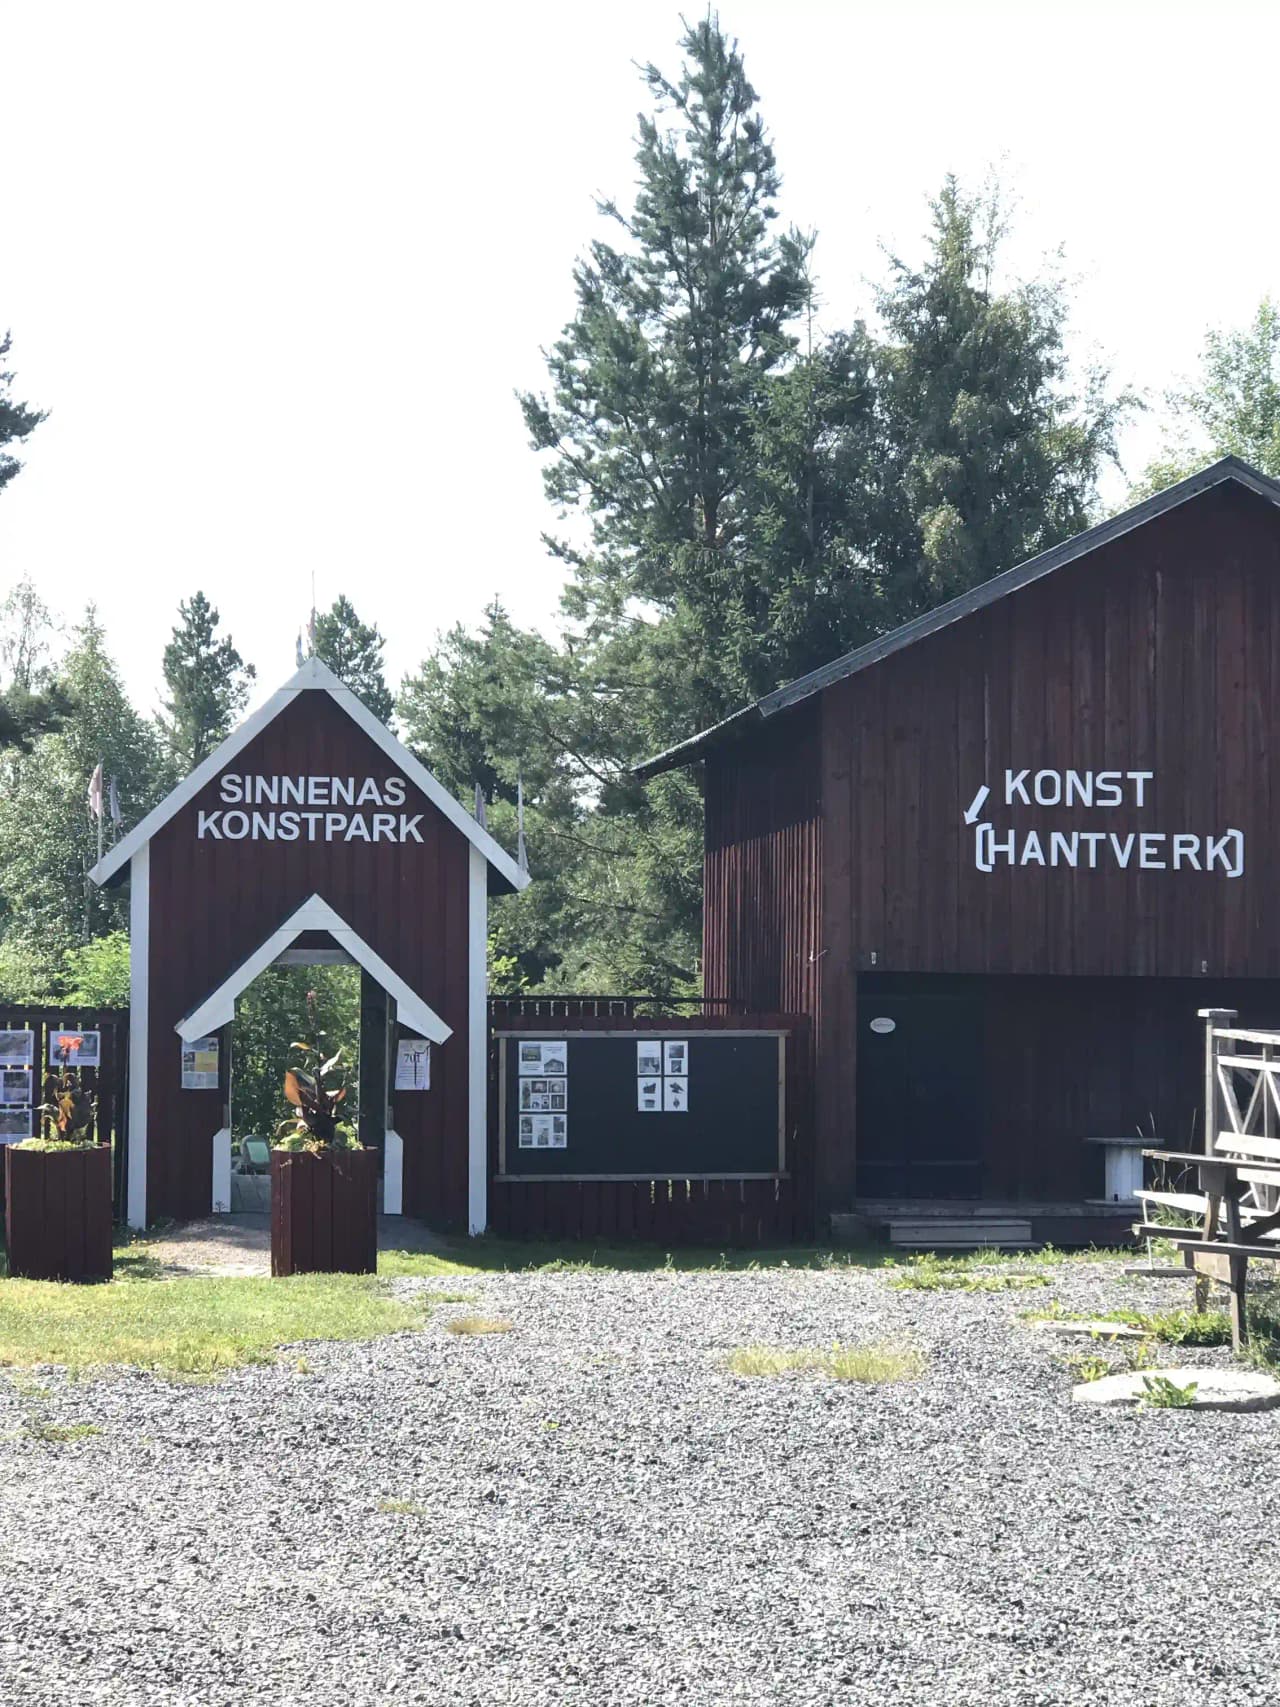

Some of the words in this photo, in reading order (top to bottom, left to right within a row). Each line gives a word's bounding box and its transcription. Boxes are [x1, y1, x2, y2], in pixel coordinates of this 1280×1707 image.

[219, 773, 406, 806] SINNENAS
[1005, 769, 1153, 807] KONST
[198, 810, 424, 843] KONSTPARK
